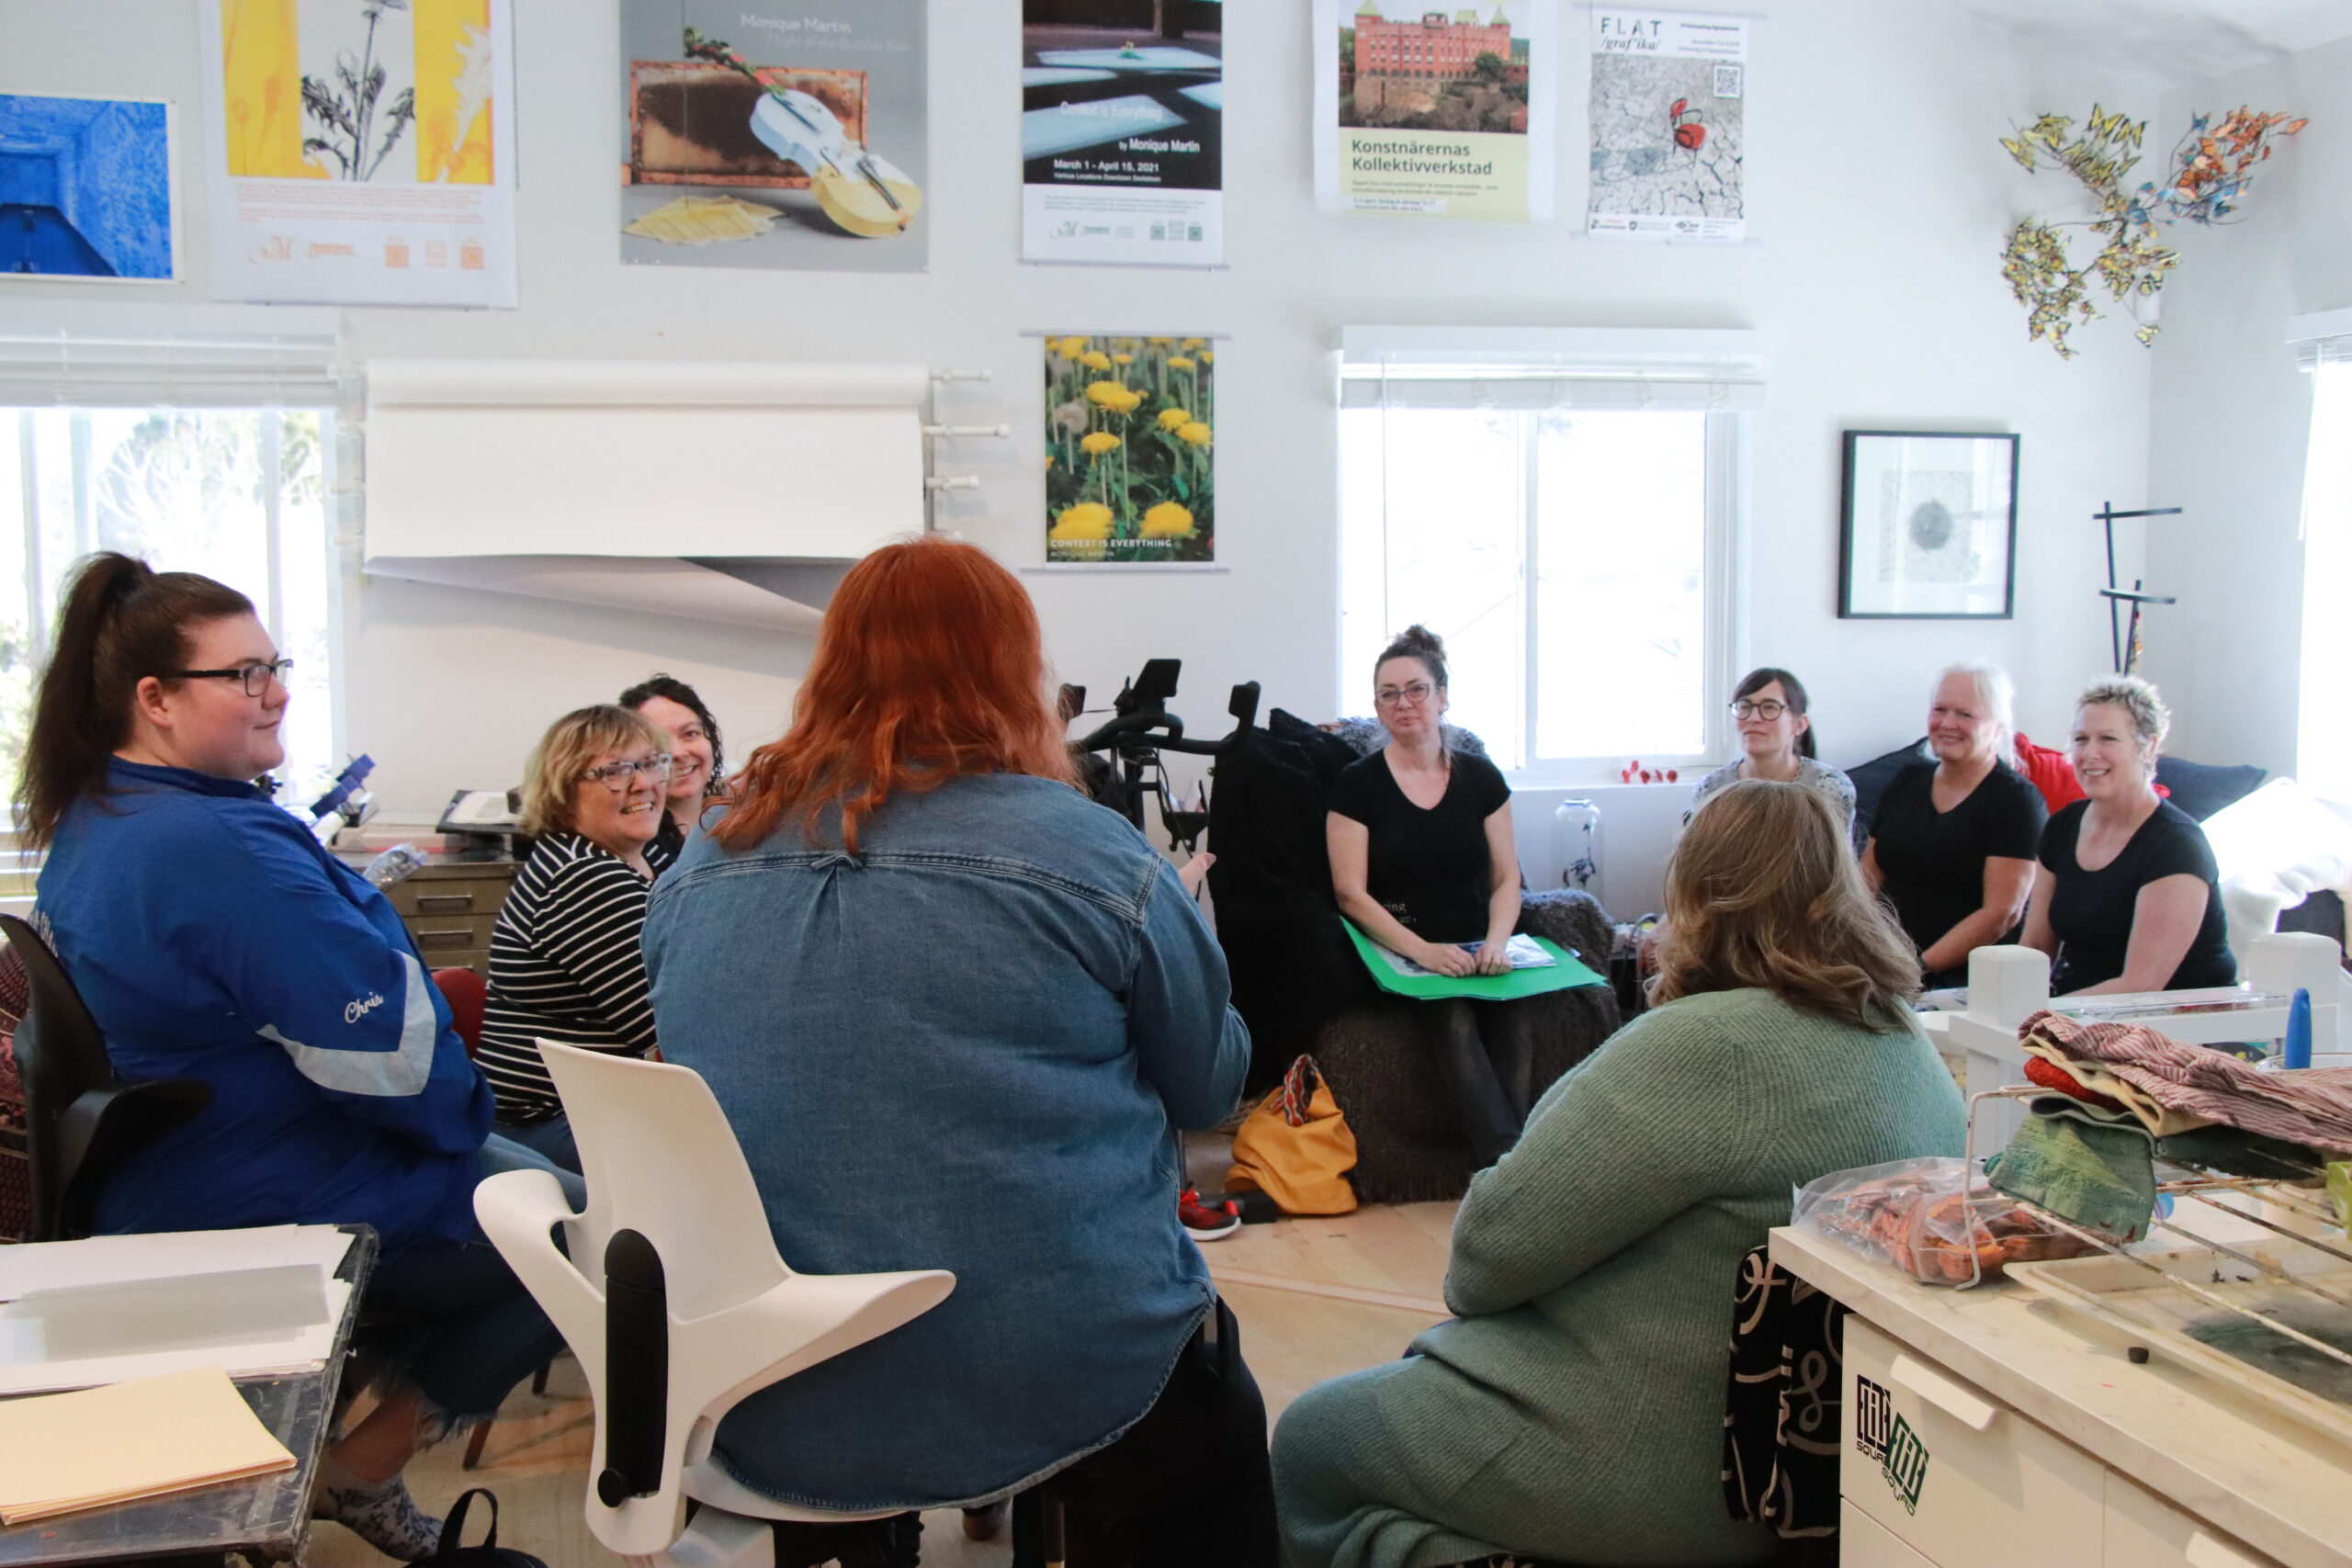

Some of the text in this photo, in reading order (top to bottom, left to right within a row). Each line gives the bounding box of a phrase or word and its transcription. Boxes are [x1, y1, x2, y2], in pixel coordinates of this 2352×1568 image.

[741, 14, 853, 34] Monique Martin
[1600, 16, 1663, 37] FLAT
[1112, 106, 1162, 122] Everything
[1129, 139, 1169, 152] Monique
[1170, 140, 1200, 152] Martin
[1351, 139, 1471, 158] Konstnärernas
[1054, 160, 1081, 170] March
[1083, 160, 1090, 170] 1
[1098, 161, 1119, 172] April
[1137, 163, 1159, 173] 2021
[1351, 156, 1493, 175] Kollektivverkstad
[1050, 538, 1172, 548] CONTEXT IS EVERYTHING
[345, 991, 384, 1024] Chris
[1857, 1440, 1885, 1465] SQUA
